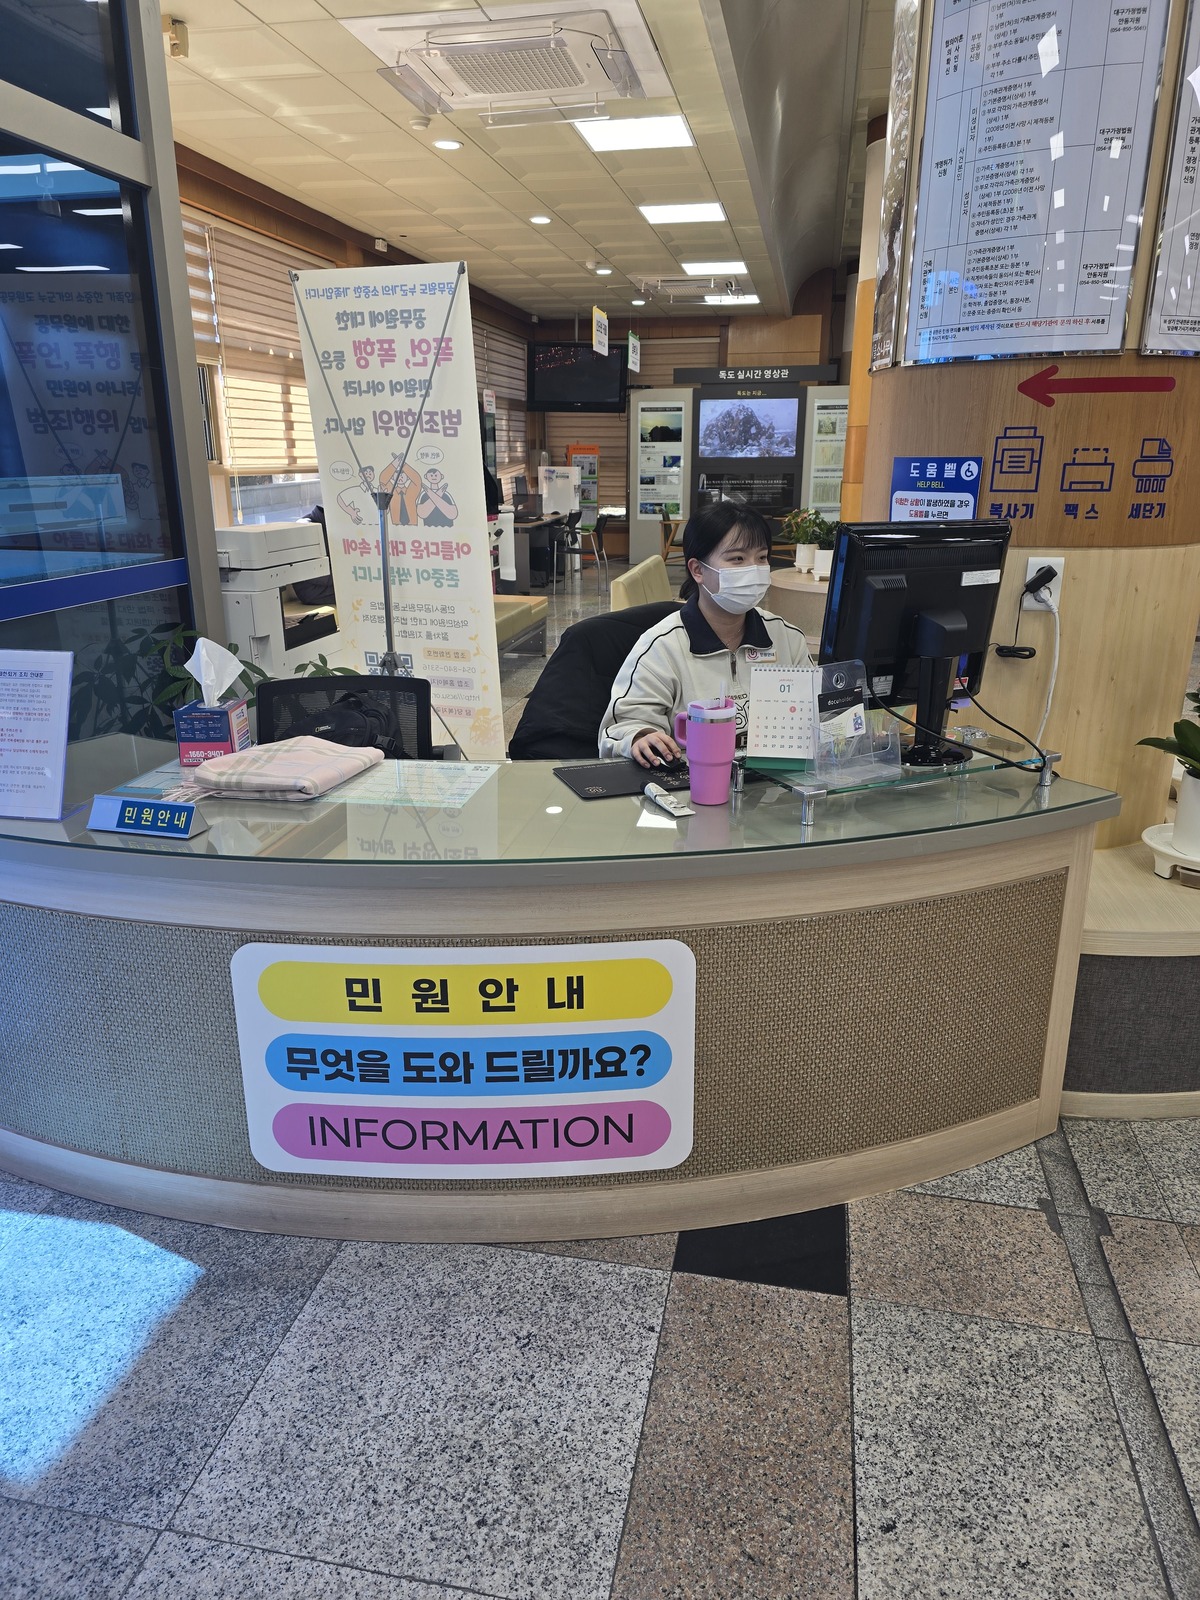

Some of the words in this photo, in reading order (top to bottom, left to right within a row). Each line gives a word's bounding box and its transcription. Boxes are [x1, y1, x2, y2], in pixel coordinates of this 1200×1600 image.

[1114, 8, 1147, 16] 대구가정법원
[1190, 146, 1196, 154] 부
[1185, 166, 1196, 174] 허가
[1183, 175, 1194, 184] 신청
[34, 314, 94, 334] 공무원에
[98, 314, 130, 333] 대한
[15, 341, 70, 370] 폭언,
[74, 341, 120, 370] 폭행
[719, 370, 735, 379] 독도
[737, 370, 761, 379] 실시간
[764, 369, 789, 378] 영상관
[46, 380, 92, 398] 민원이
[96, 381, 142, 397] 아니라
[26, 407, 119, 435] 범죄행위
[895, 498, 909, 506] 위험한
[910, 498, 925, 506] 상황이
[927, 499, 955, 508] 발생하였을
[957, 500, 969, 508] 경우
[909, 510, 929, 518] 도움벨을
[931, 511, 948, 519] 누르면
[989, 503, 1035, 520] 복사기
[1128, 503, 1166, 519] 세단기
[780, 684, 791, 693] 01
[286, 1046, 390, 1083] 무엇을
[403, 1051, 474, 1084] 도와
[485, 1044, 651, 1082] 드릴까요?
[308, 1113, 634, 1151] INFORMATION
